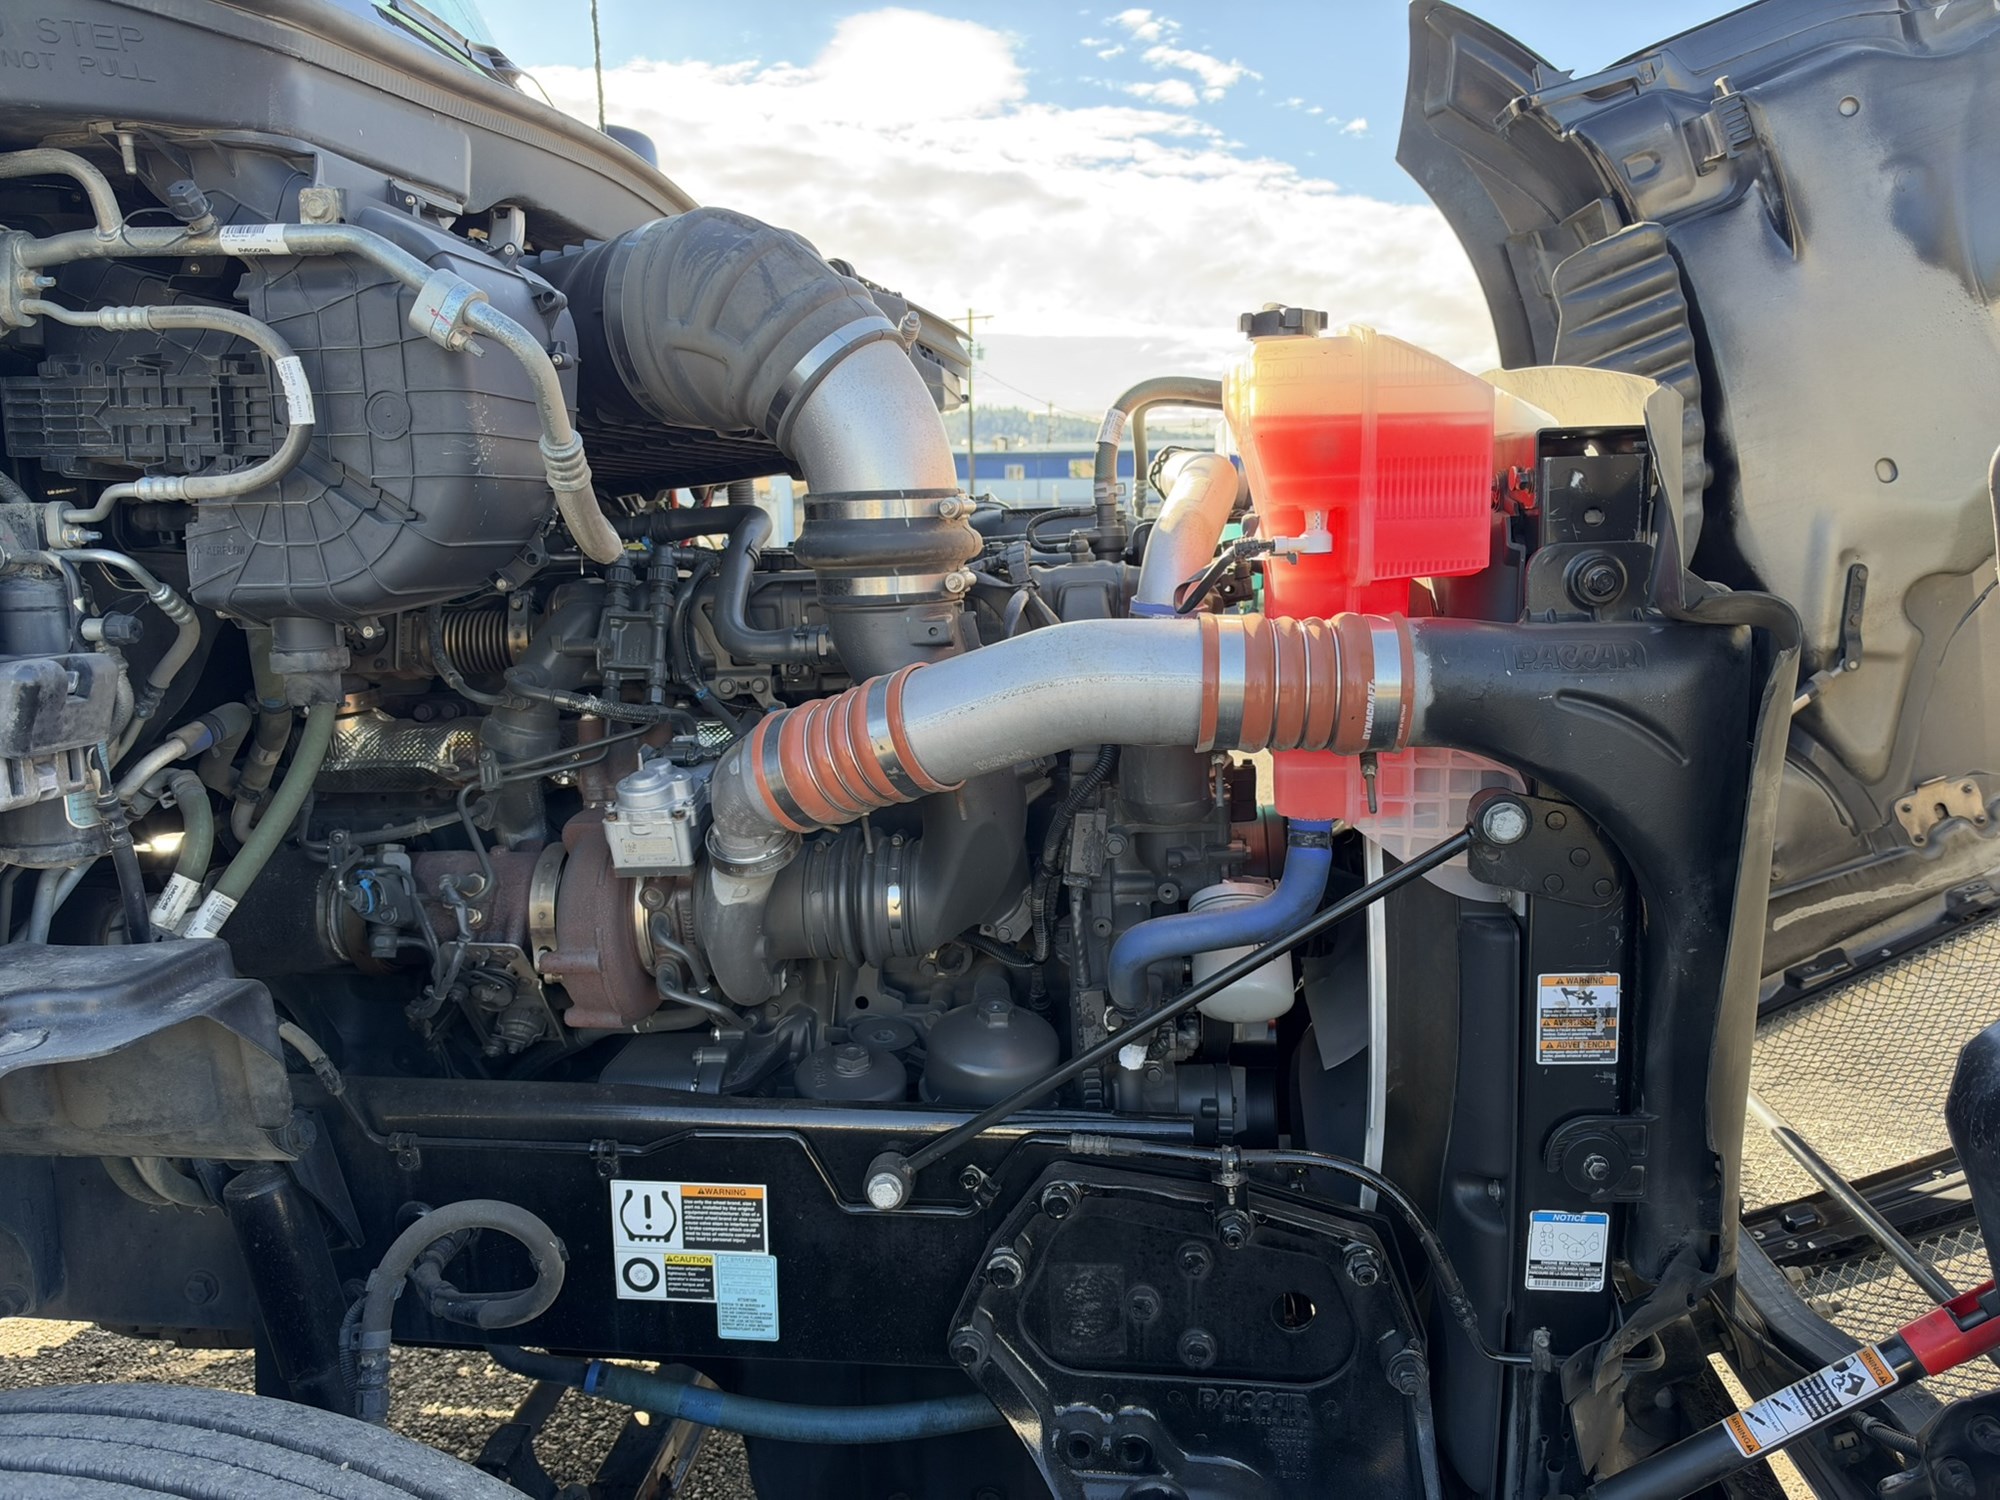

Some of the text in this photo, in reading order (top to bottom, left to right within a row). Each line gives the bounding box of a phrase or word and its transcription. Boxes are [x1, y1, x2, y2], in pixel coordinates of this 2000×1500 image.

[35, 18, 144, 53] STEP
[79, 56, 156, 83] PULL
[1513, 644, 1640, 670] PACCAR
[161, 885, 179, 910] PACCAR
[1556, 1041, 1611, 1049] ADVETENCIA
[705, 1188, 747, 1196] WARNING
[1552, 1214, 1587, 1222] NOTICE
[673, 1255, 712, 1263] CAUTION
[1863, 1350, 1883, 1376] ARNING
[1198, 1387, 1309, 1414] PACCAR
[1789, 1395, 1803, 1415] Locked
[1802, 1397, 1816, 1417] closing
[1809, 1394, 1824, 1415] prevent
[1824, 1390, 1836, 1405] hood.
[1763, 1407, 1779, 1431] Unlocked
